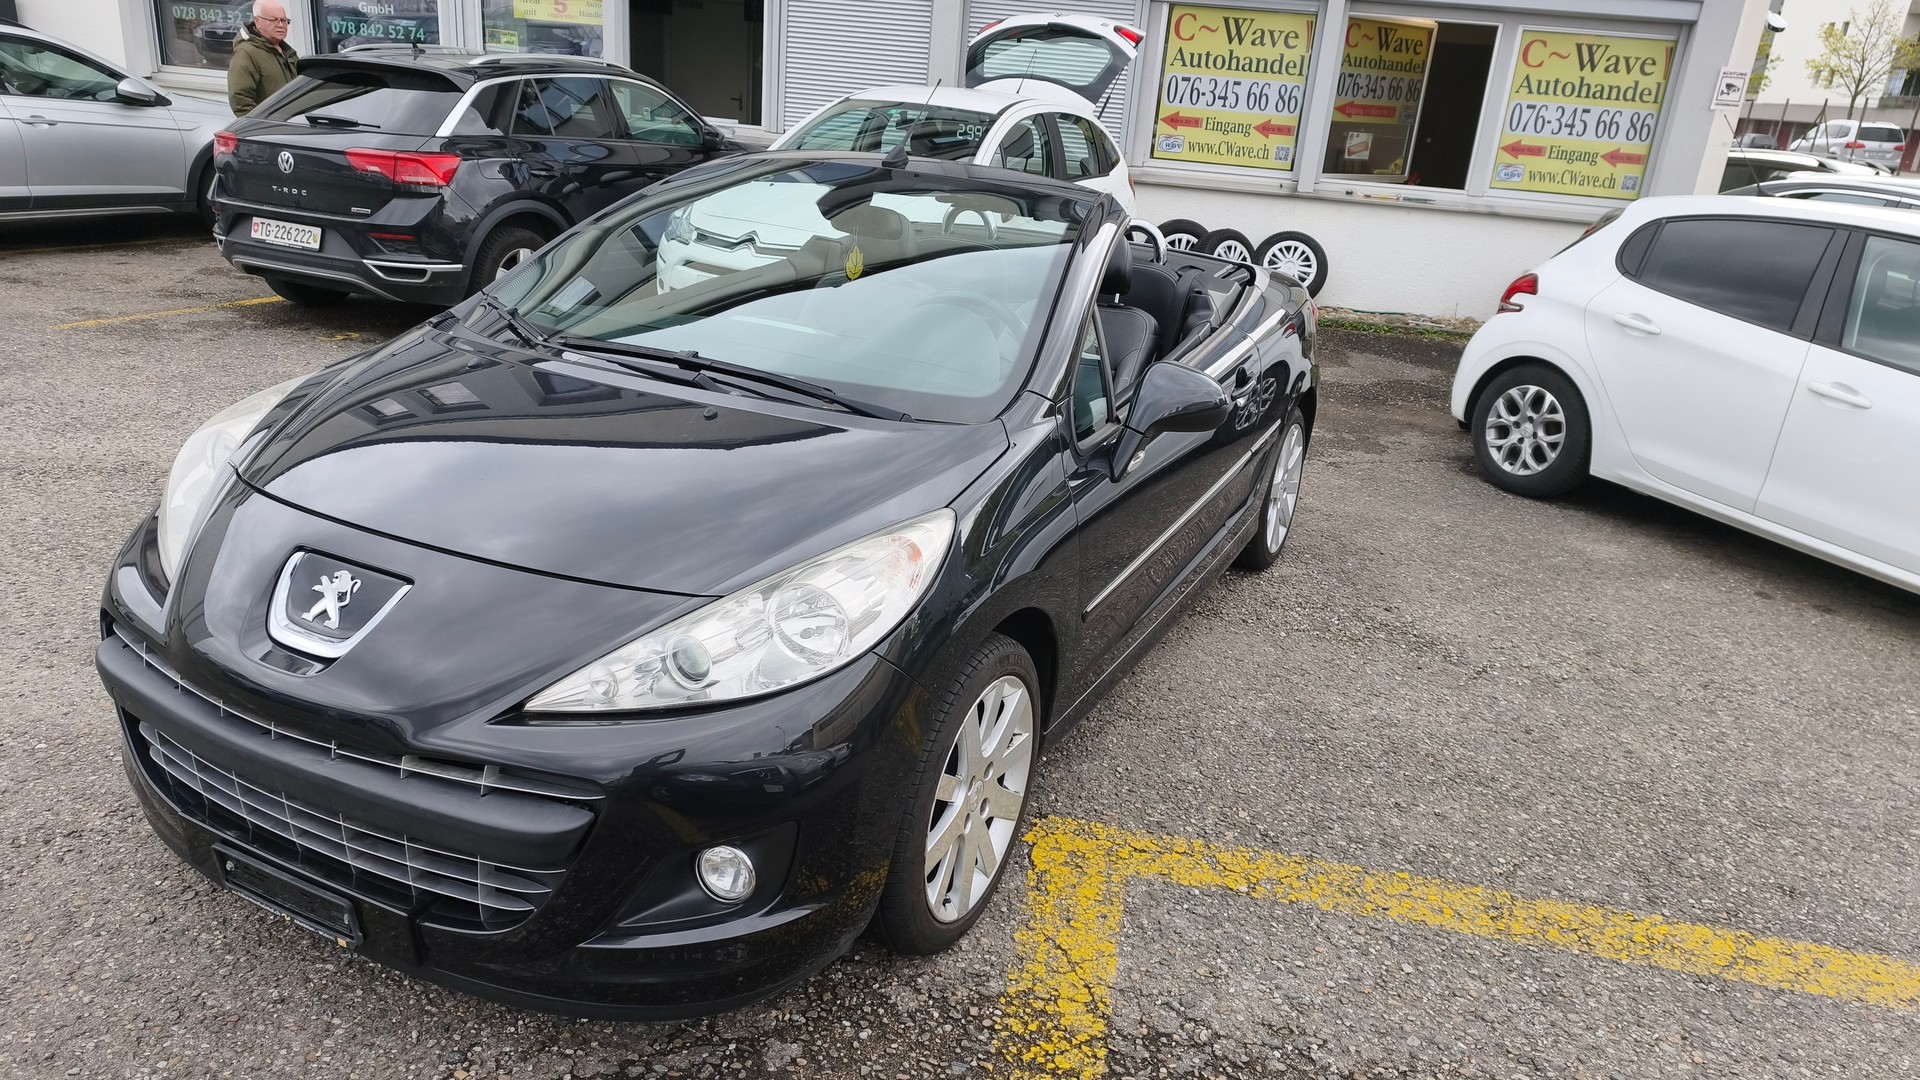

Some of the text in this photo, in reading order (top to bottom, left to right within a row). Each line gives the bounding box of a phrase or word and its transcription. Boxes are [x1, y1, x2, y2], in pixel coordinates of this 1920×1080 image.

[173, 5, 196, 20] 078
[200, 8, 222, 22] 842
[226, 10, 241, 23] 52
[358, 2, 394, 14] GmbH
[523, 8, 537, 16] mit
[553, 0, 568, 13] 5
[331, 20, 425, 41] 078 842 52 74
[1169, 46, 1306, 77] Autohandel
[1341, 52, 1426, 74] Autohandel
[1166, 75, 1301, 114] 076-345 66 86
[1336, 71, 1422, 102] 076-345 66 86
[1514, 73, 1662, 104] Autohandel
[957, 123, 987, 141] 299
[1204, 116, 1252, 138] Eingang
[1509, 102, 1654, 143] 076-345 66 86
[1188, 140, 1269, 160] www.CWave.ch
[1547, 145, 1600, 166] Eingang
[1529, 169, 1616, 190] www.CWave.ch
